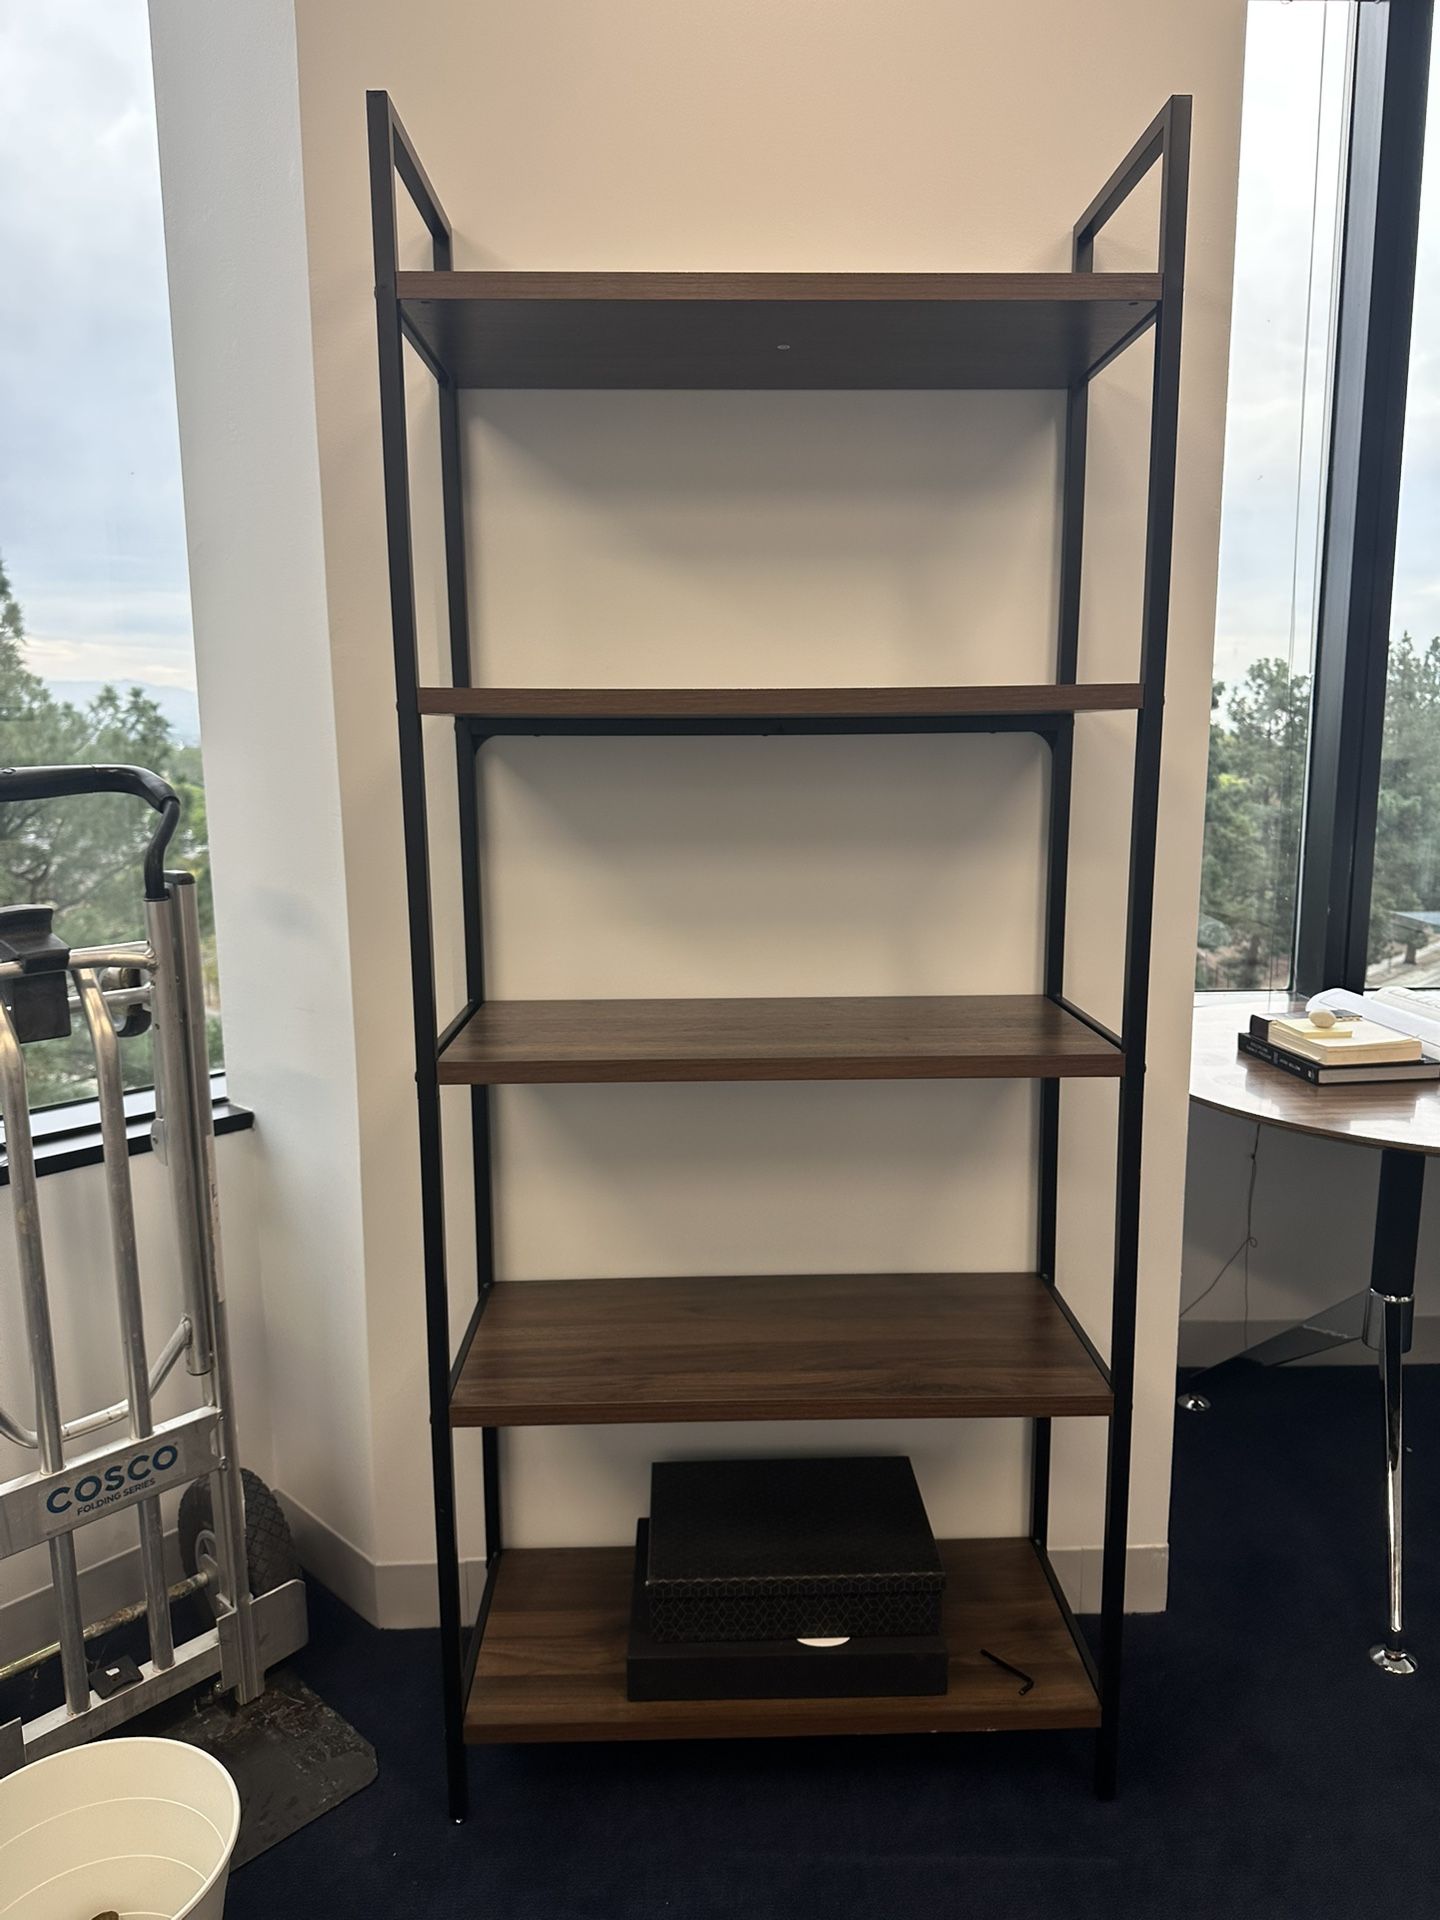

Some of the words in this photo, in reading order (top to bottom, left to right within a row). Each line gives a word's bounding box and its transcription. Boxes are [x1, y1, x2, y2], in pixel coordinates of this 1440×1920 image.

[46, 1445, 178, 1513] COSCO
[77, 1492, 122, 1516] FOLDING
[123, 1478, 156, 1497] SERIES
